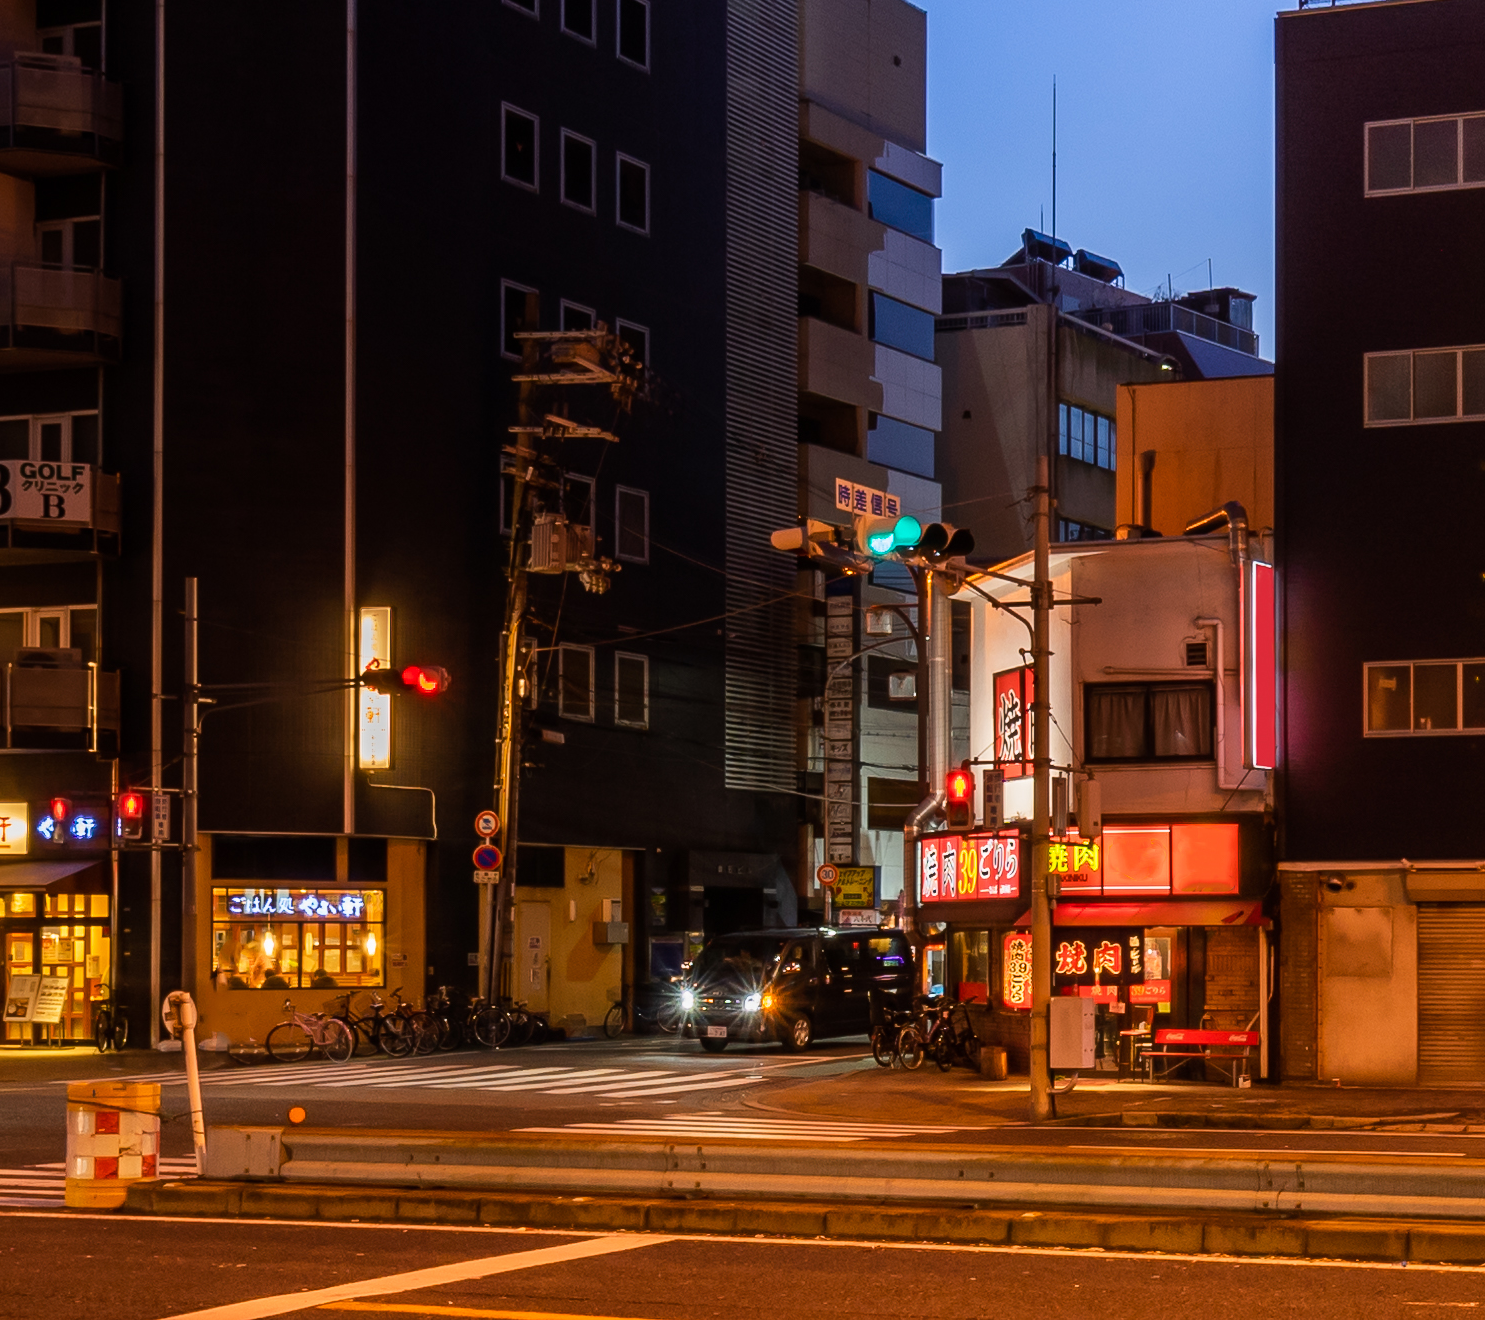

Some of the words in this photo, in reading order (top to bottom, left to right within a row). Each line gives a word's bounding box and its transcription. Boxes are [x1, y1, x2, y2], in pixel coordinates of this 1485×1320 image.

[20, 462, 85, 481] GOLF
[21, 480, 84, 494] クリニック
[41, 493, 66, 518] B
[838, 484, 898, 517] 時差信号
[821, 869, 834, 880] 30
[1059, 873, 1088, 882] KINIKU
[229, 895, 295, 914] ごはん処
[298, 894, 365, 918] やよい軒
[1055, 940, 1122, 975] 焼肉
